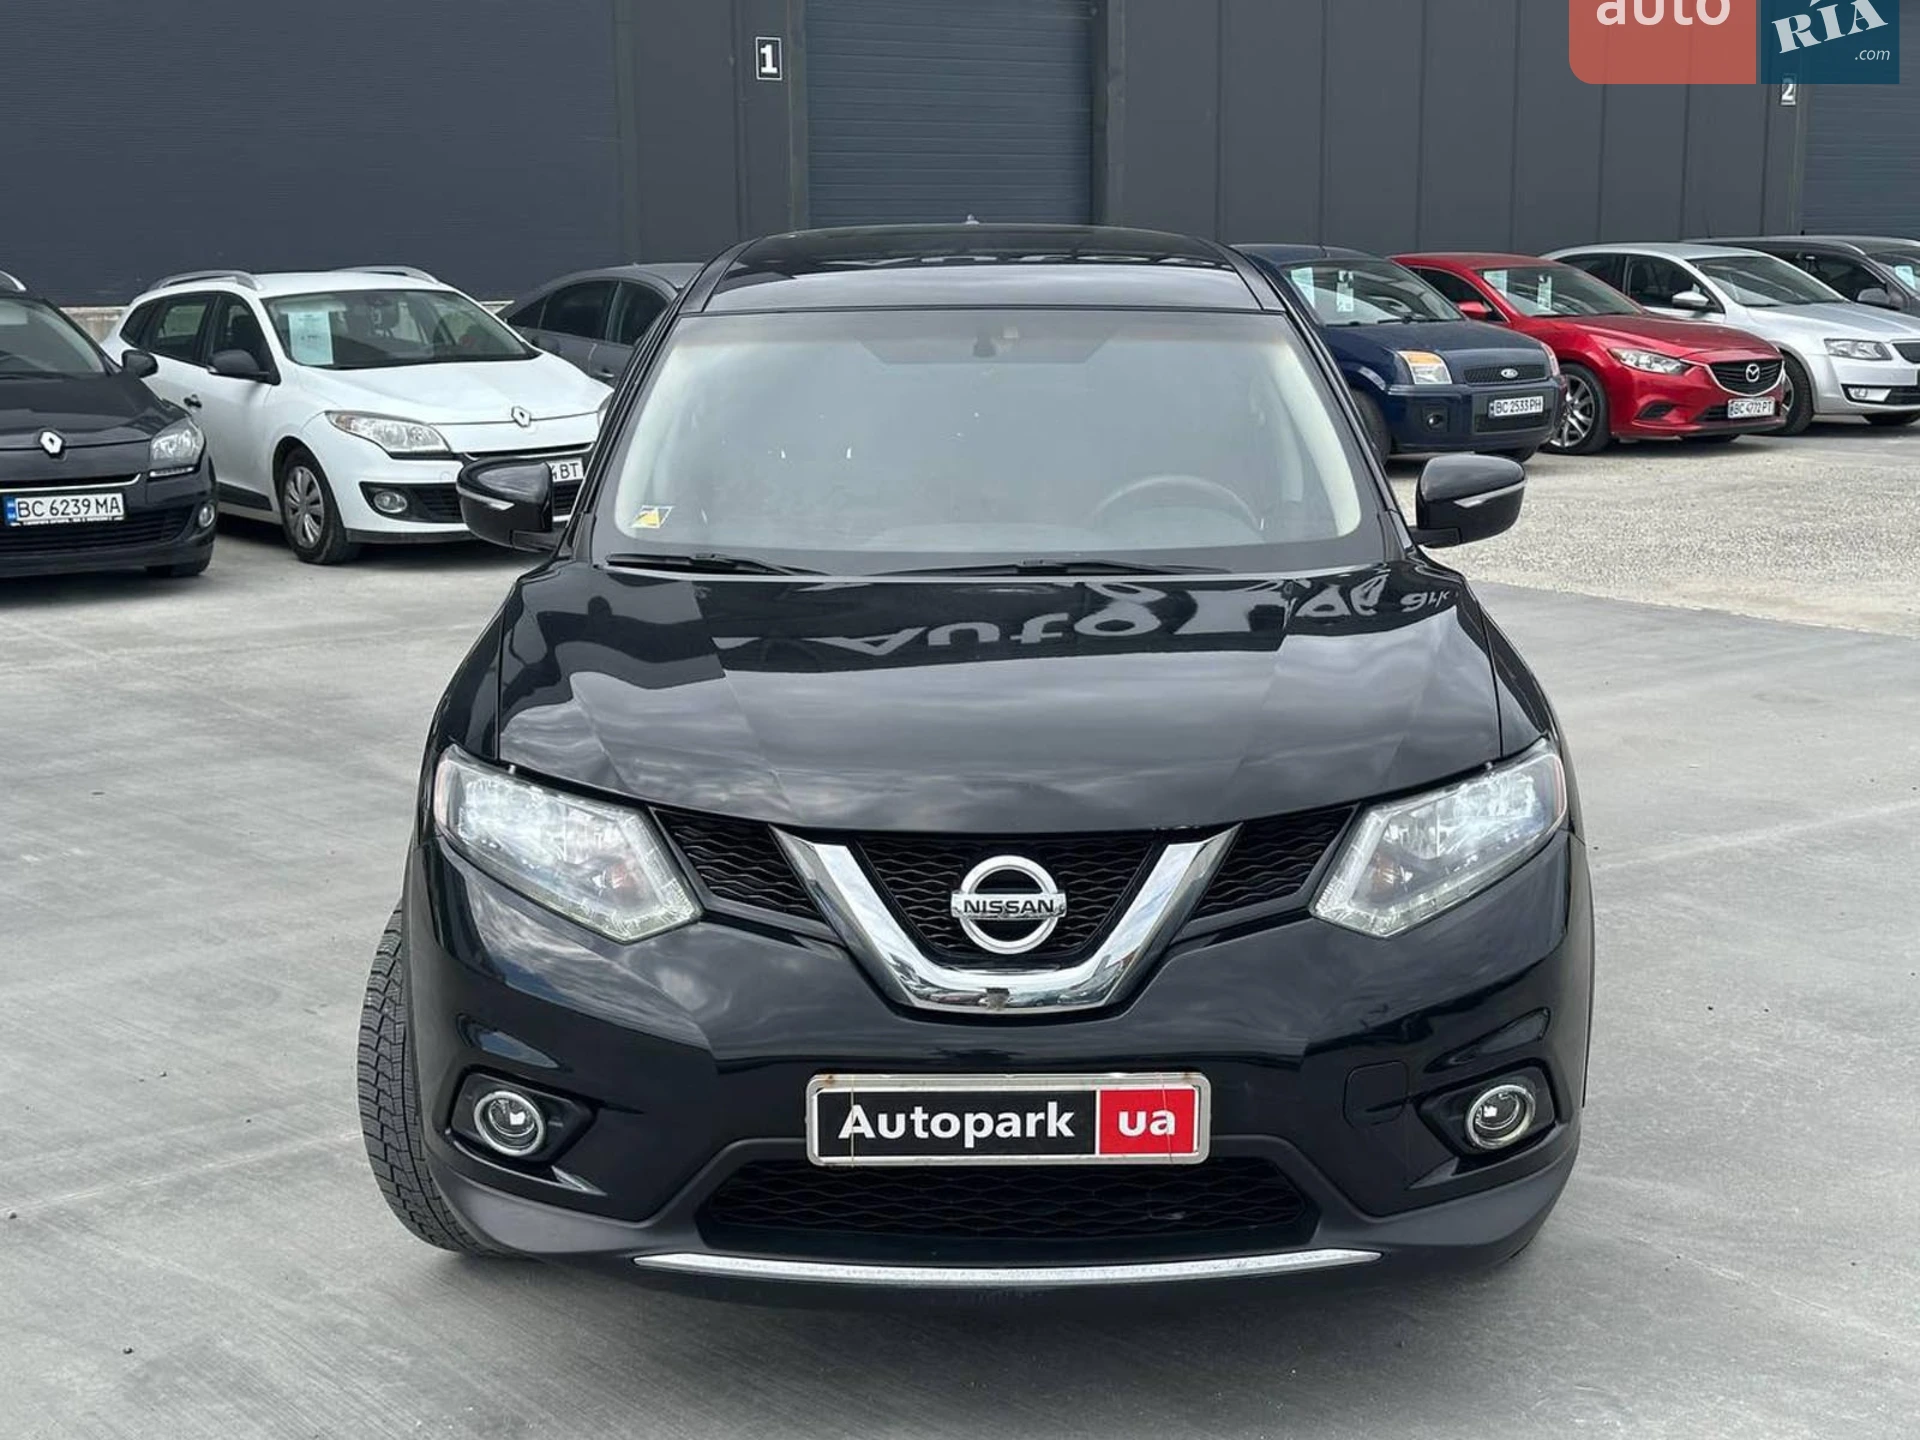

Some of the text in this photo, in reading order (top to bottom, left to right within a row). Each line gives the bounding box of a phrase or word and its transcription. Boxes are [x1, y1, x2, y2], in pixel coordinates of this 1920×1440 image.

[760, 44, 778, 74] 1
[1781, 77, 1795, 101] 2
[1495, 401, 1508, 415] BC
[17, 497, 121, 518] BC 6239 MA
[963, 899, 1055, 915] NISSAN
[838, 1101, 1177, 1149] Autopark ua
